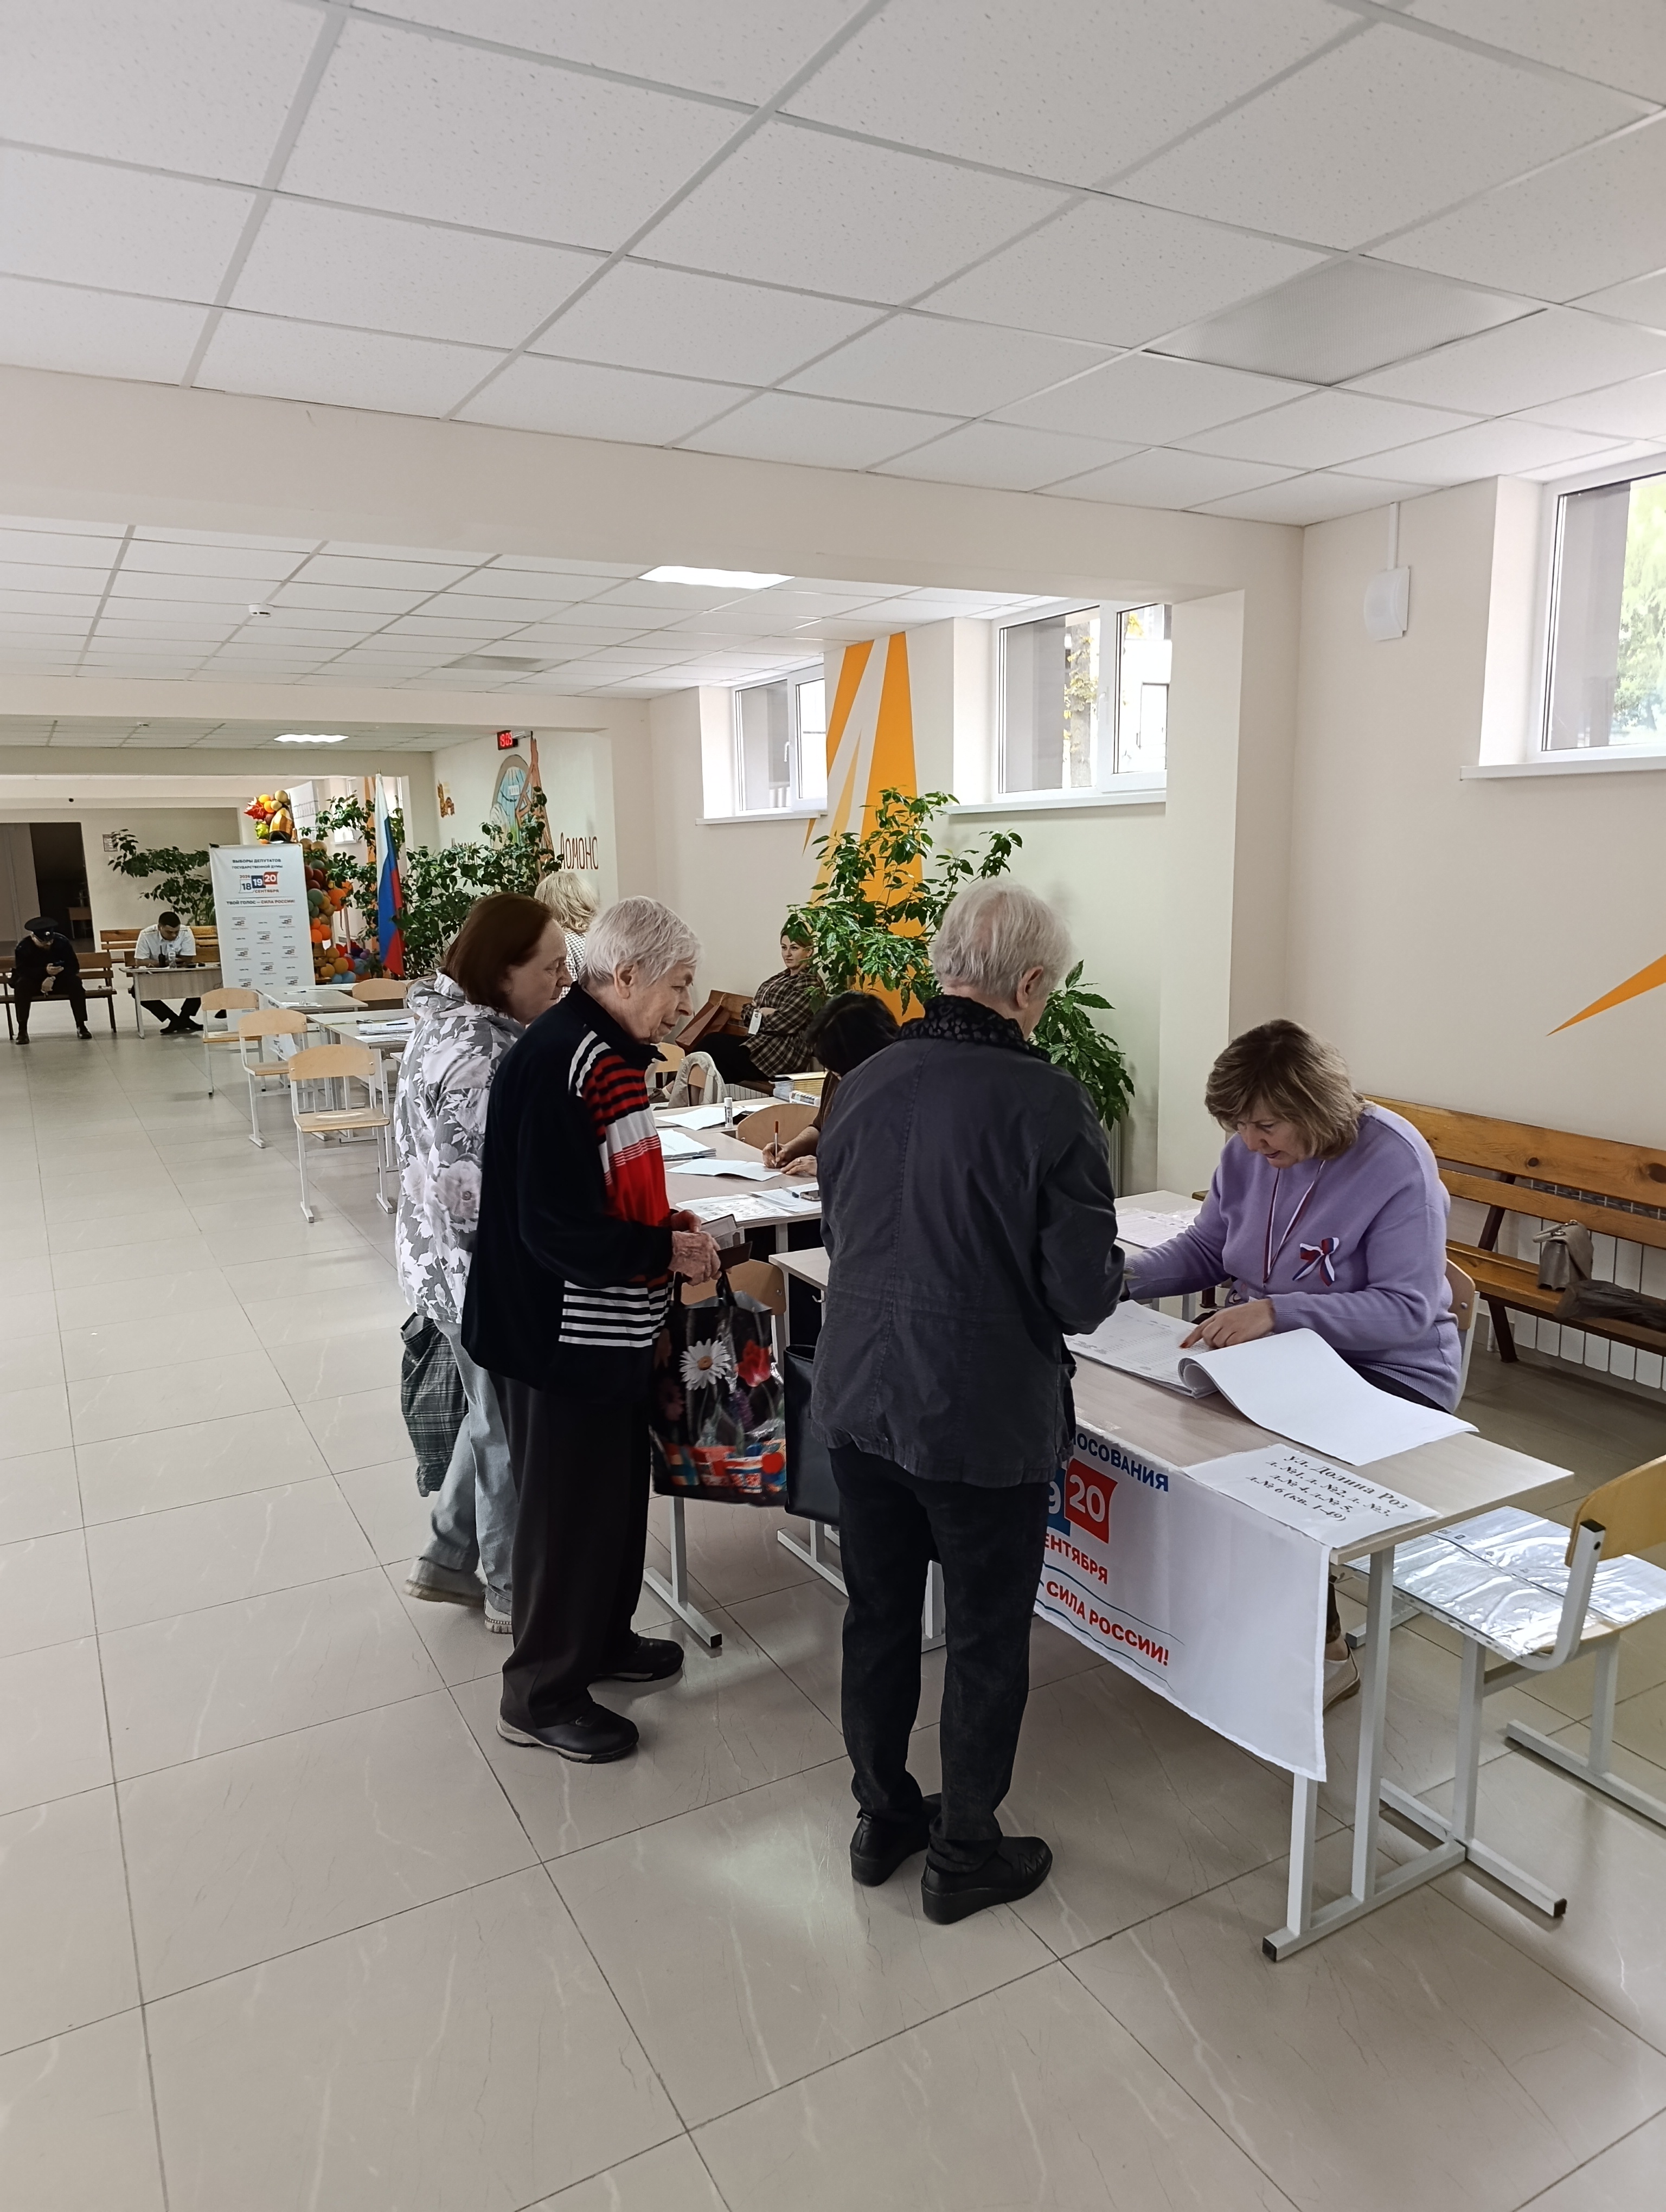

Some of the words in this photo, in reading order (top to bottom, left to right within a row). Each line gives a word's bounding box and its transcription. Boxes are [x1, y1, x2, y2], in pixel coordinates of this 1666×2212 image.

[264, 874, 277, 882] 20
[1073, 1432, 1169, 1492] ОСОВАНИЯ
[1284, 1456, 1308, 1467] ул.
[1309, 1465, 1375, 1494] Долина
[1377, 1493, 1409, 1509] Роз
[1069, 1474, 1105, 1522] 20
[1283, 1493, 1308, 1506] (кв.
[1046, 1581, 1086, 1620] СИЛА
[1089, 1609, 1169, 1666] РОССИИ!
